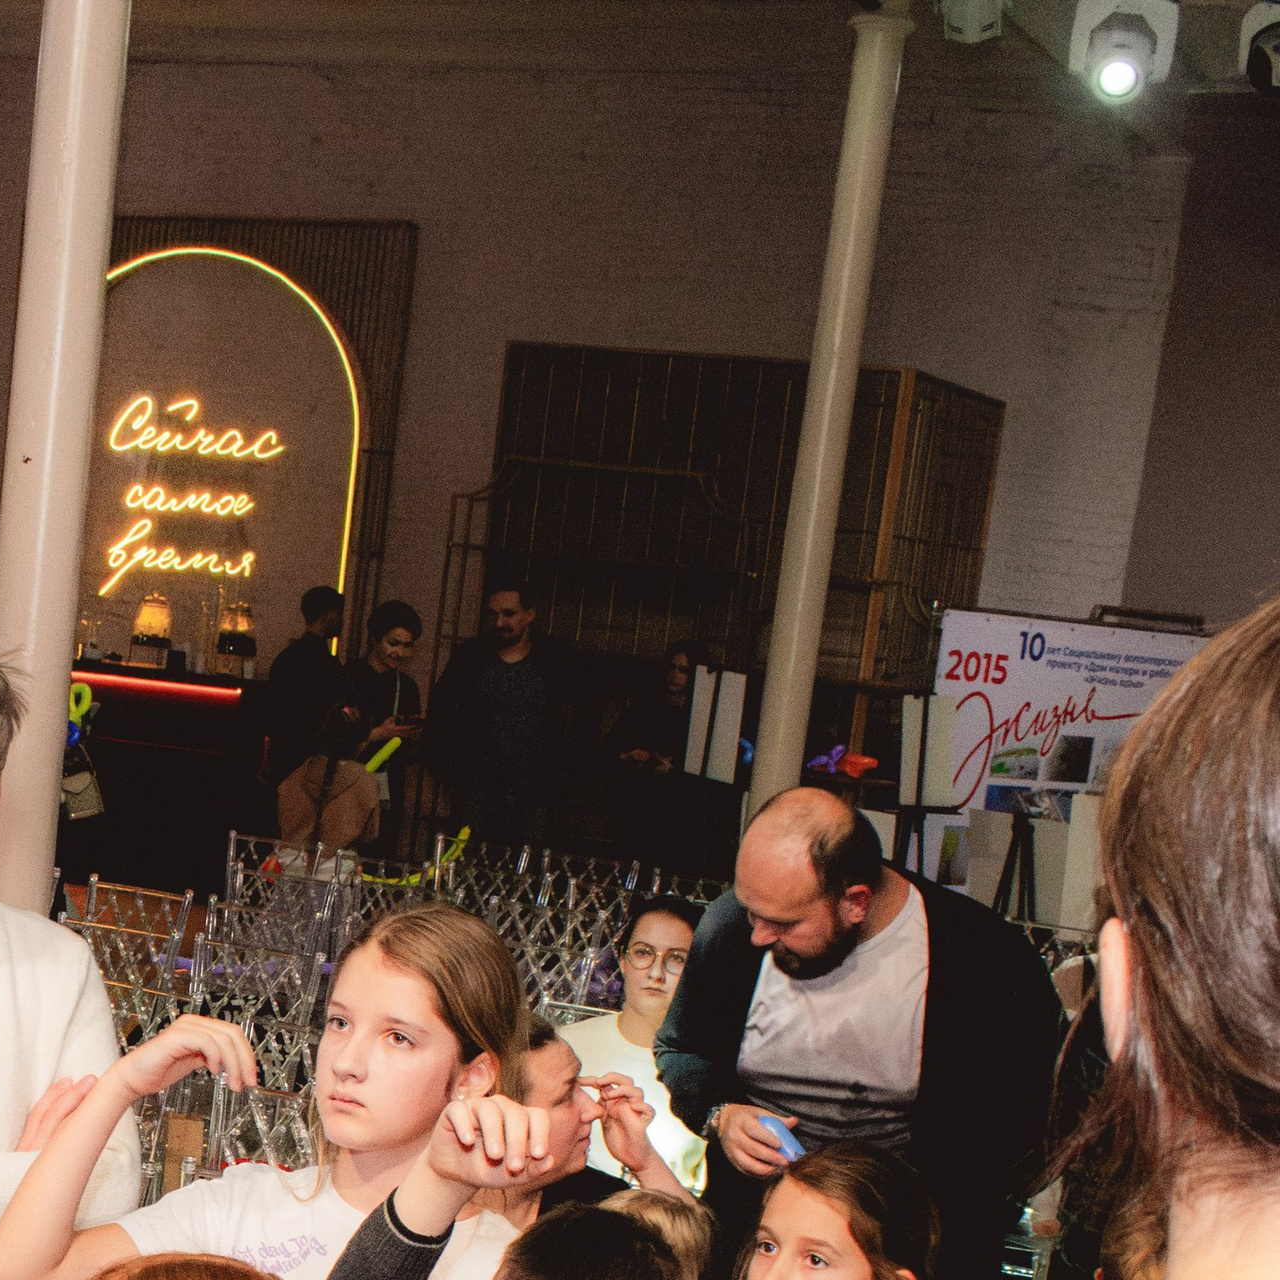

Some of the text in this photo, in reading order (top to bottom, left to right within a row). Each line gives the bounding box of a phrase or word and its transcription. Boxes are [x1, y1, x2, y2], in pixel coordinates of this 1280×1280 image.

[108, 395, 285, 459] Сейчас
[124, 483, 256, 517] самое
[97, 517, 256, 597] время
[944, 649, 1010, 686] 2015
[1019, 630, 1046, 663] 10
[952, 686, 1143, 810] Жизнь
